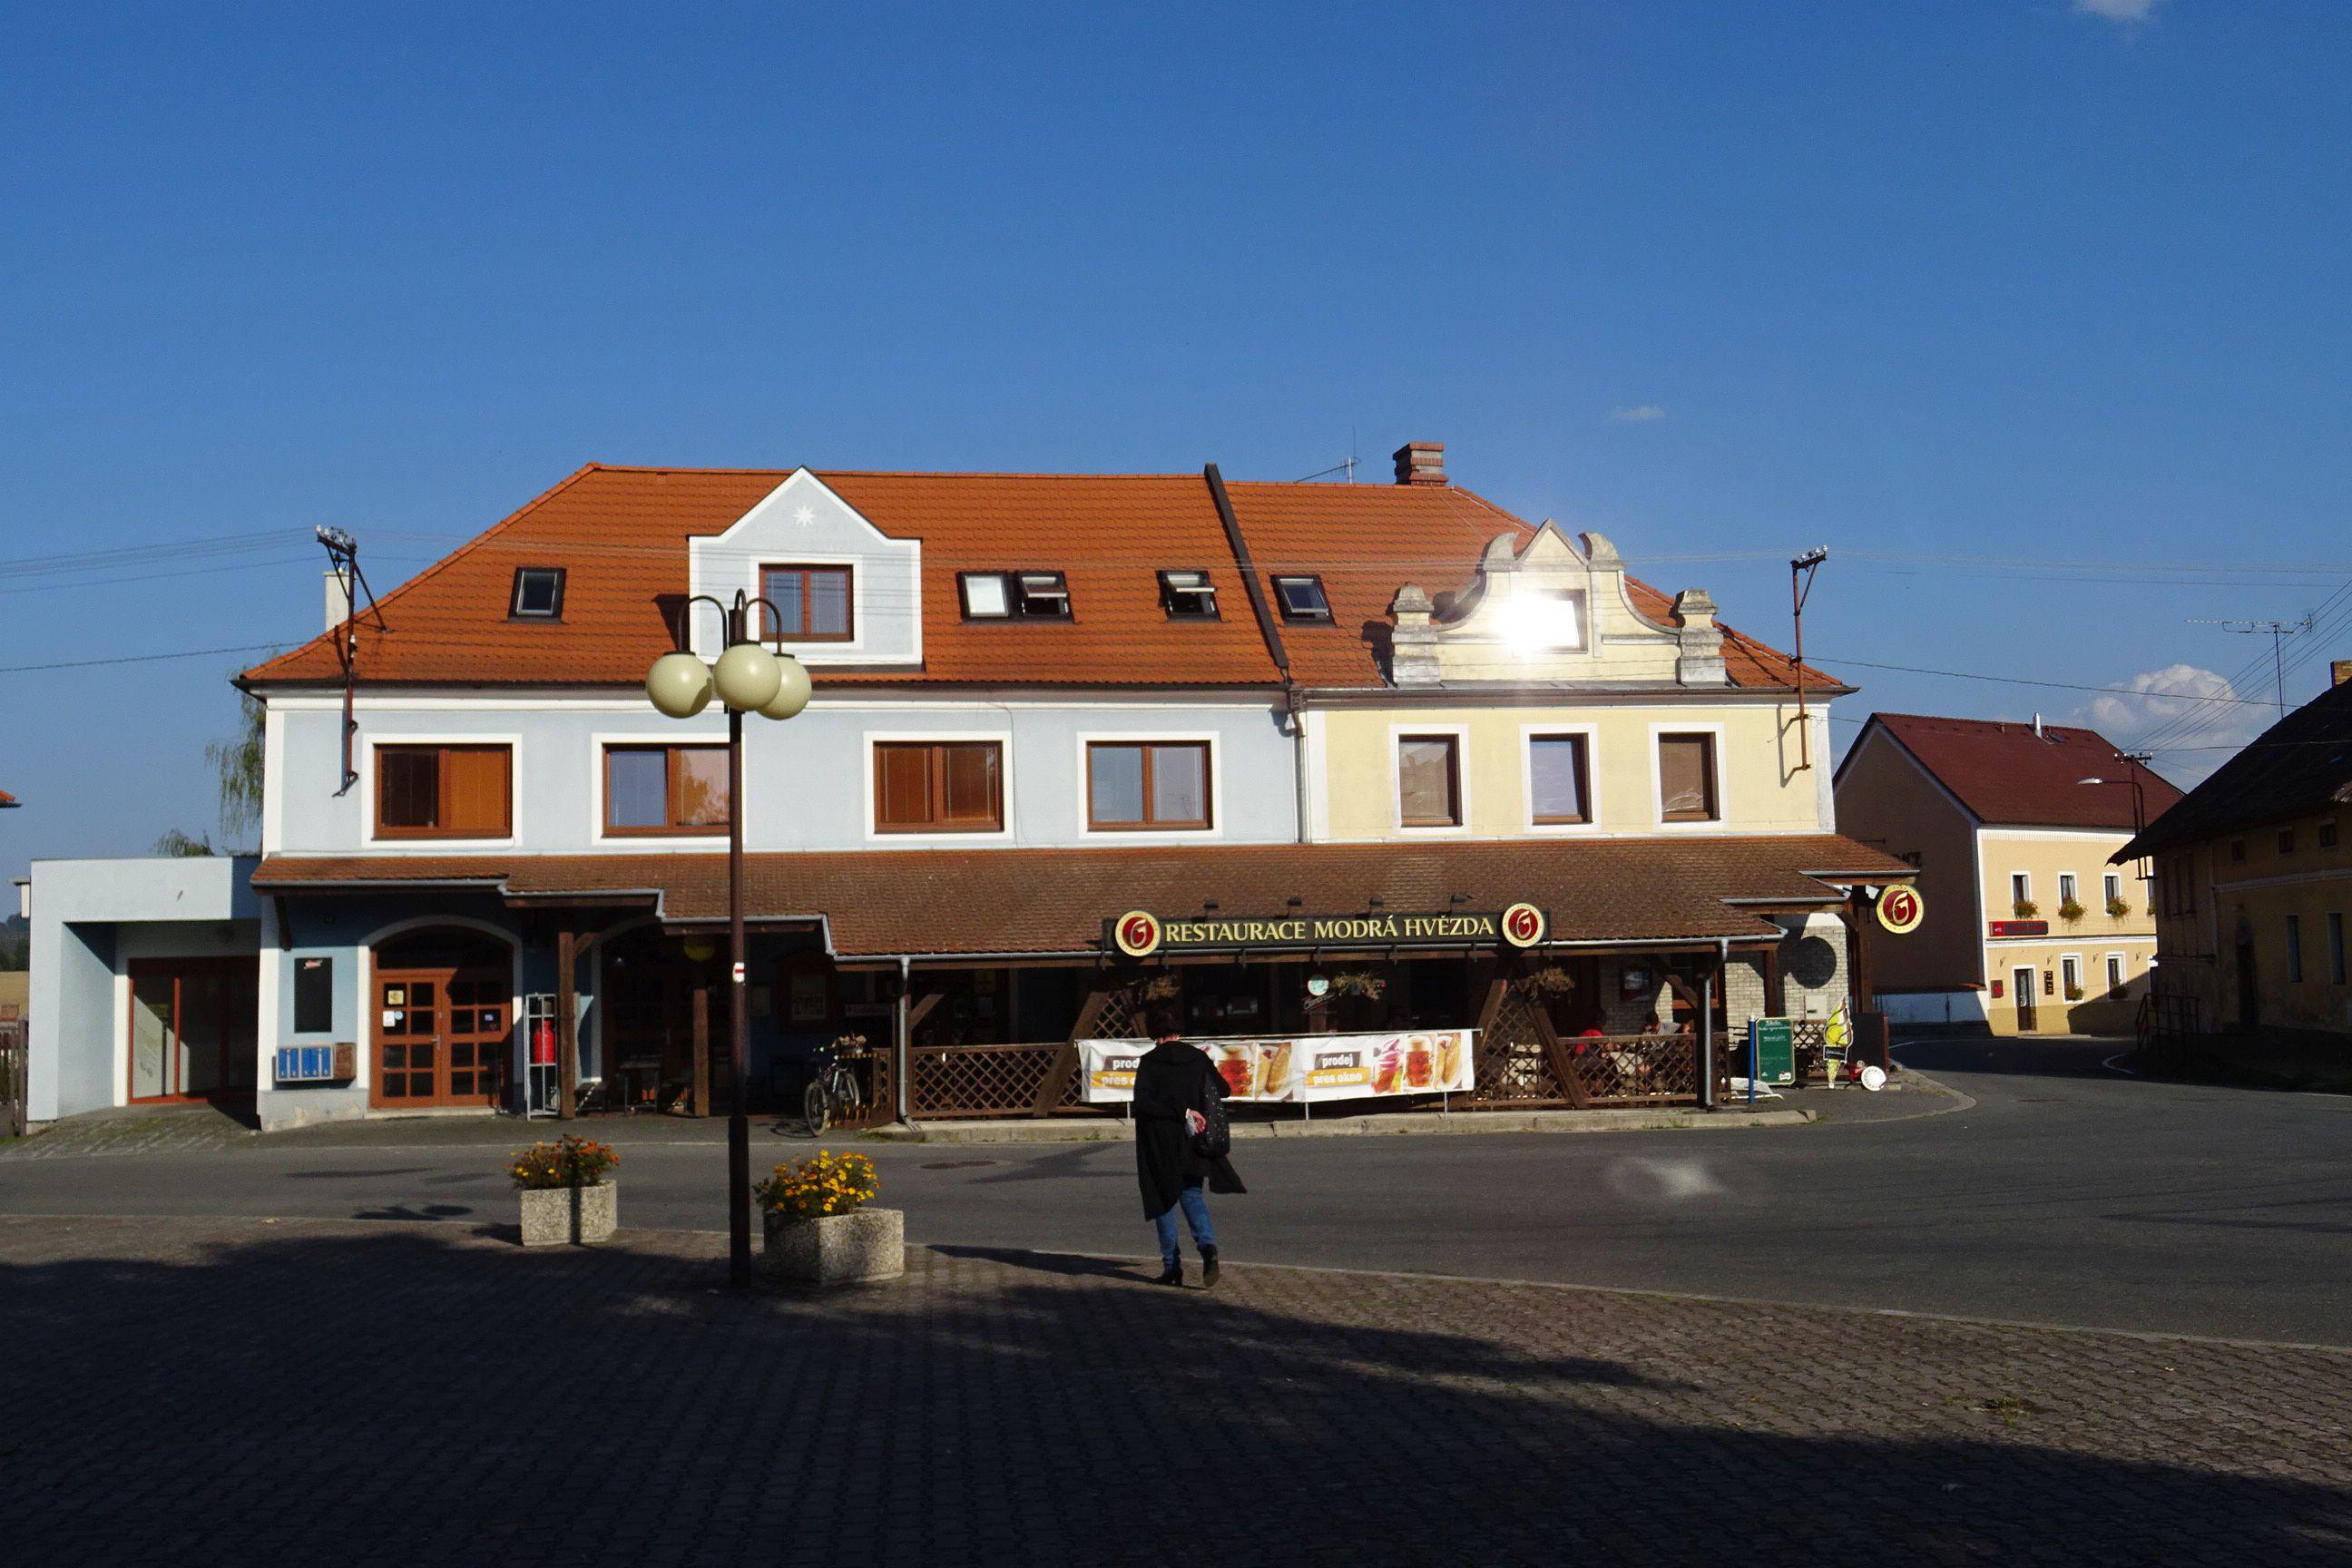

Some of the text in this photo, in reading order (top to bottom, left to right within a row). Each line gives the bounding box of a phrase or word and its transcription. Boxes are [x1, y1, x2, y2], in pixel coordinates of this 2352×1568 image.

[1165, 915, 1494, 942] RESTAURACE MODRÁ HVĚZDA
[1112, 1058, 1141, 1071] prod
[1322, 1054, 1354, 1069] prodej
